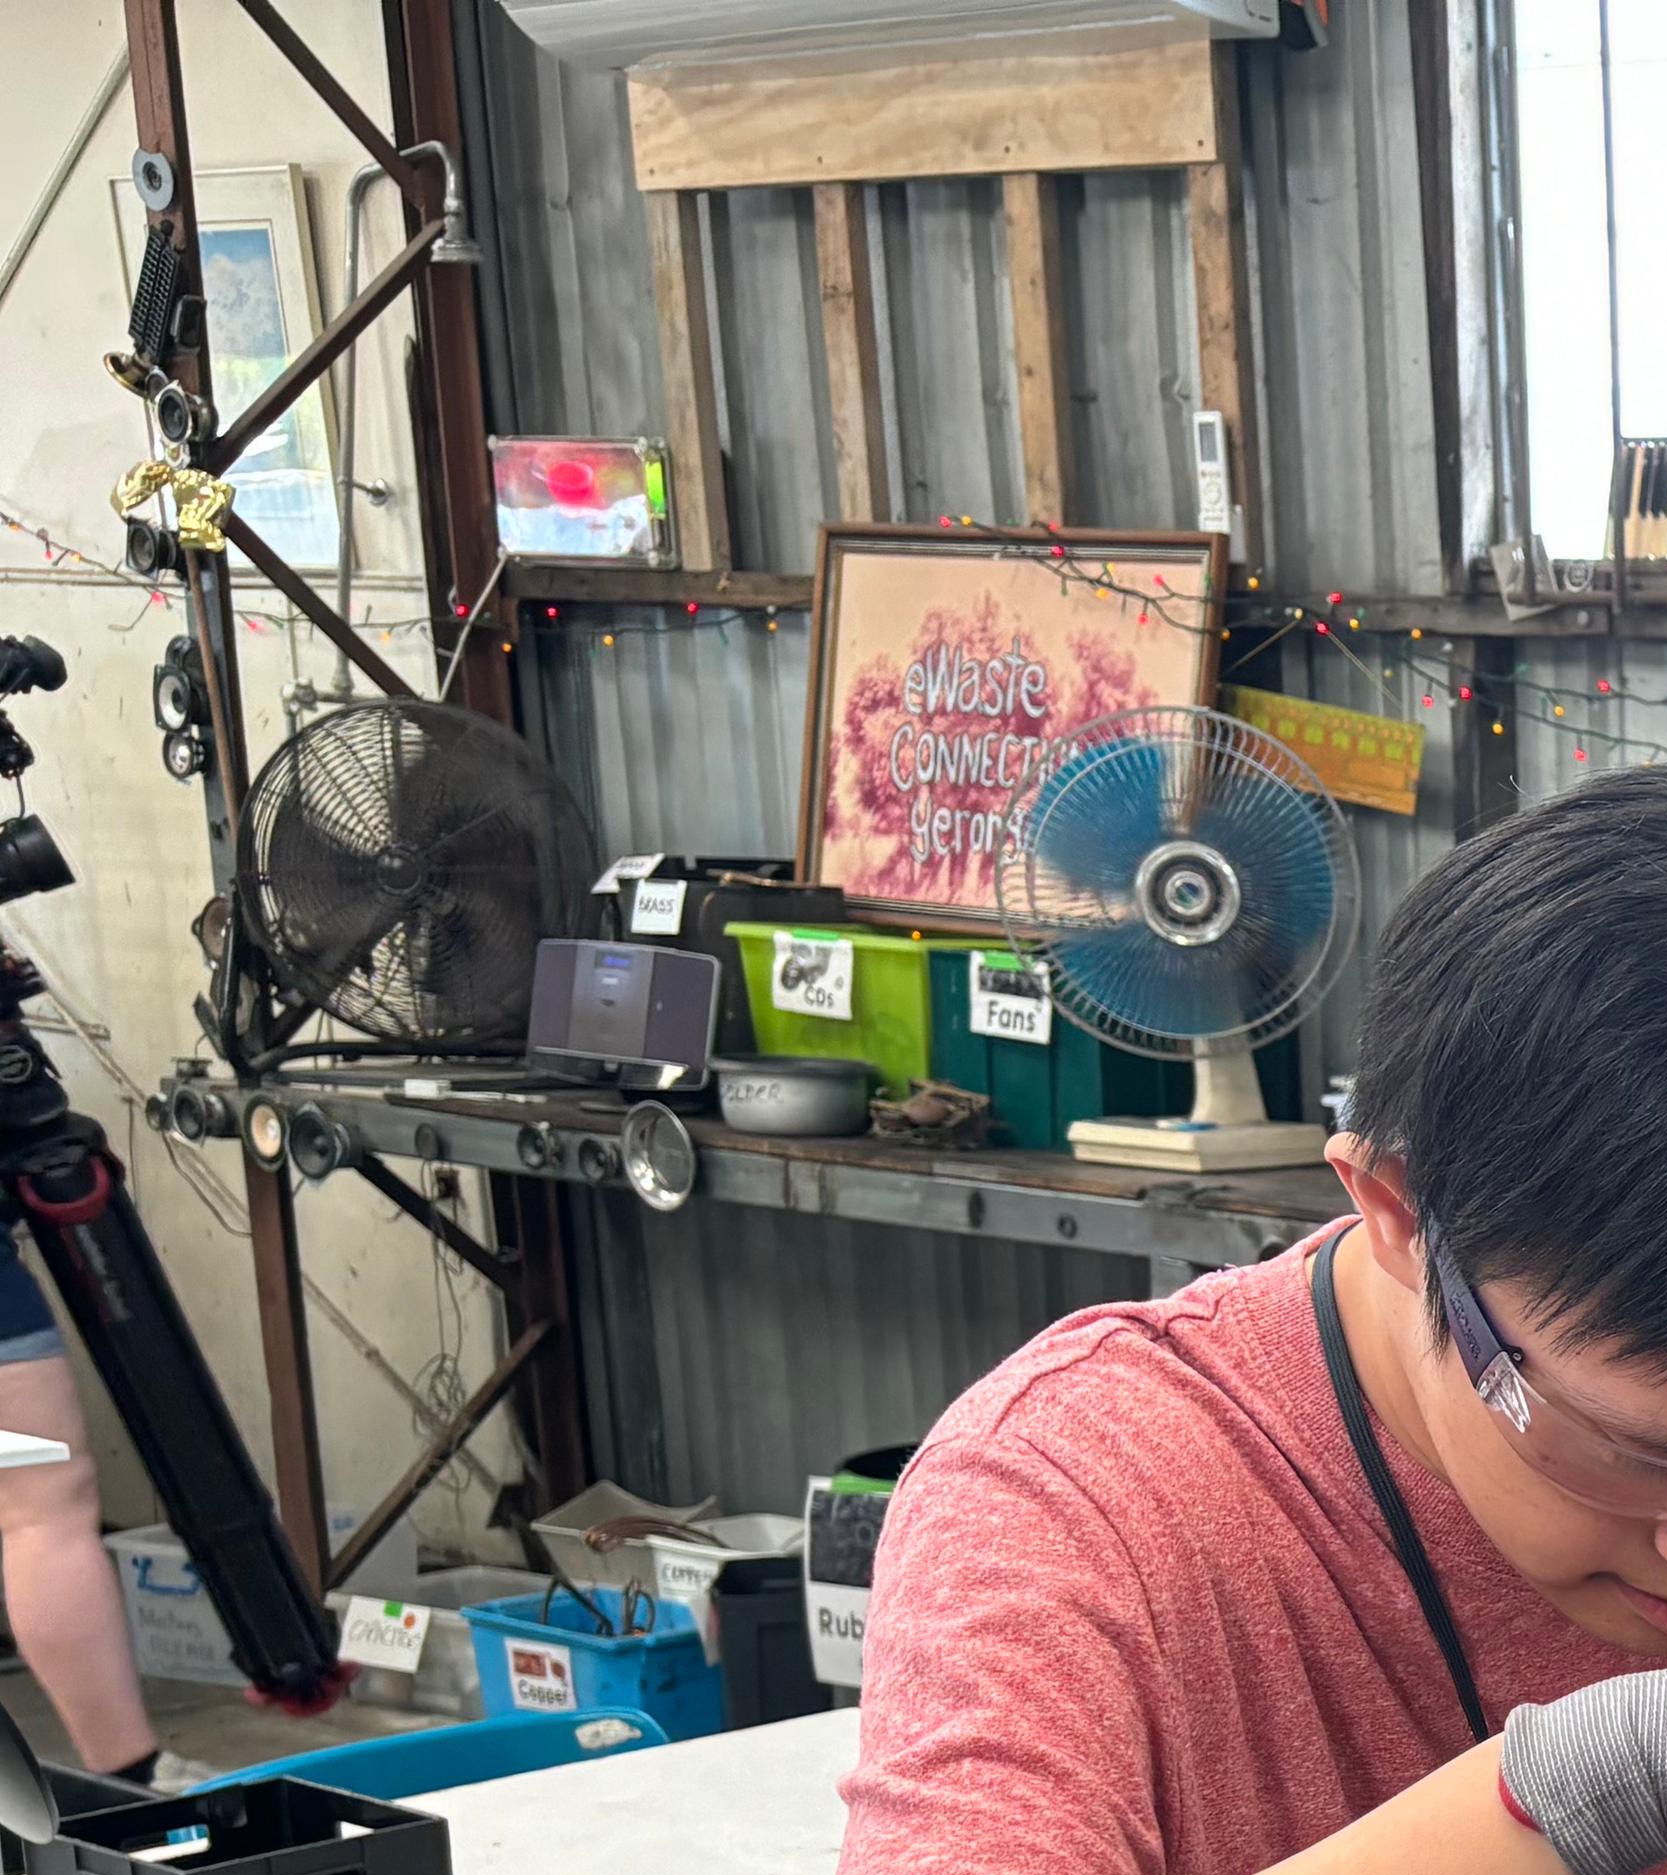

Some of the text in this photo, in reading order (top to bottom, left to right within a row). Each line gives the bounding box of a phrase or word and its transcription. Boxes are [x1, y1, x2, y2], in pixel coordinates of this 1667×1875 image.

[904, 636, 1048, 719] eWaste
[804, 985, 834, 1009] CDs
[987, 999, 1036, 1033] Fans
